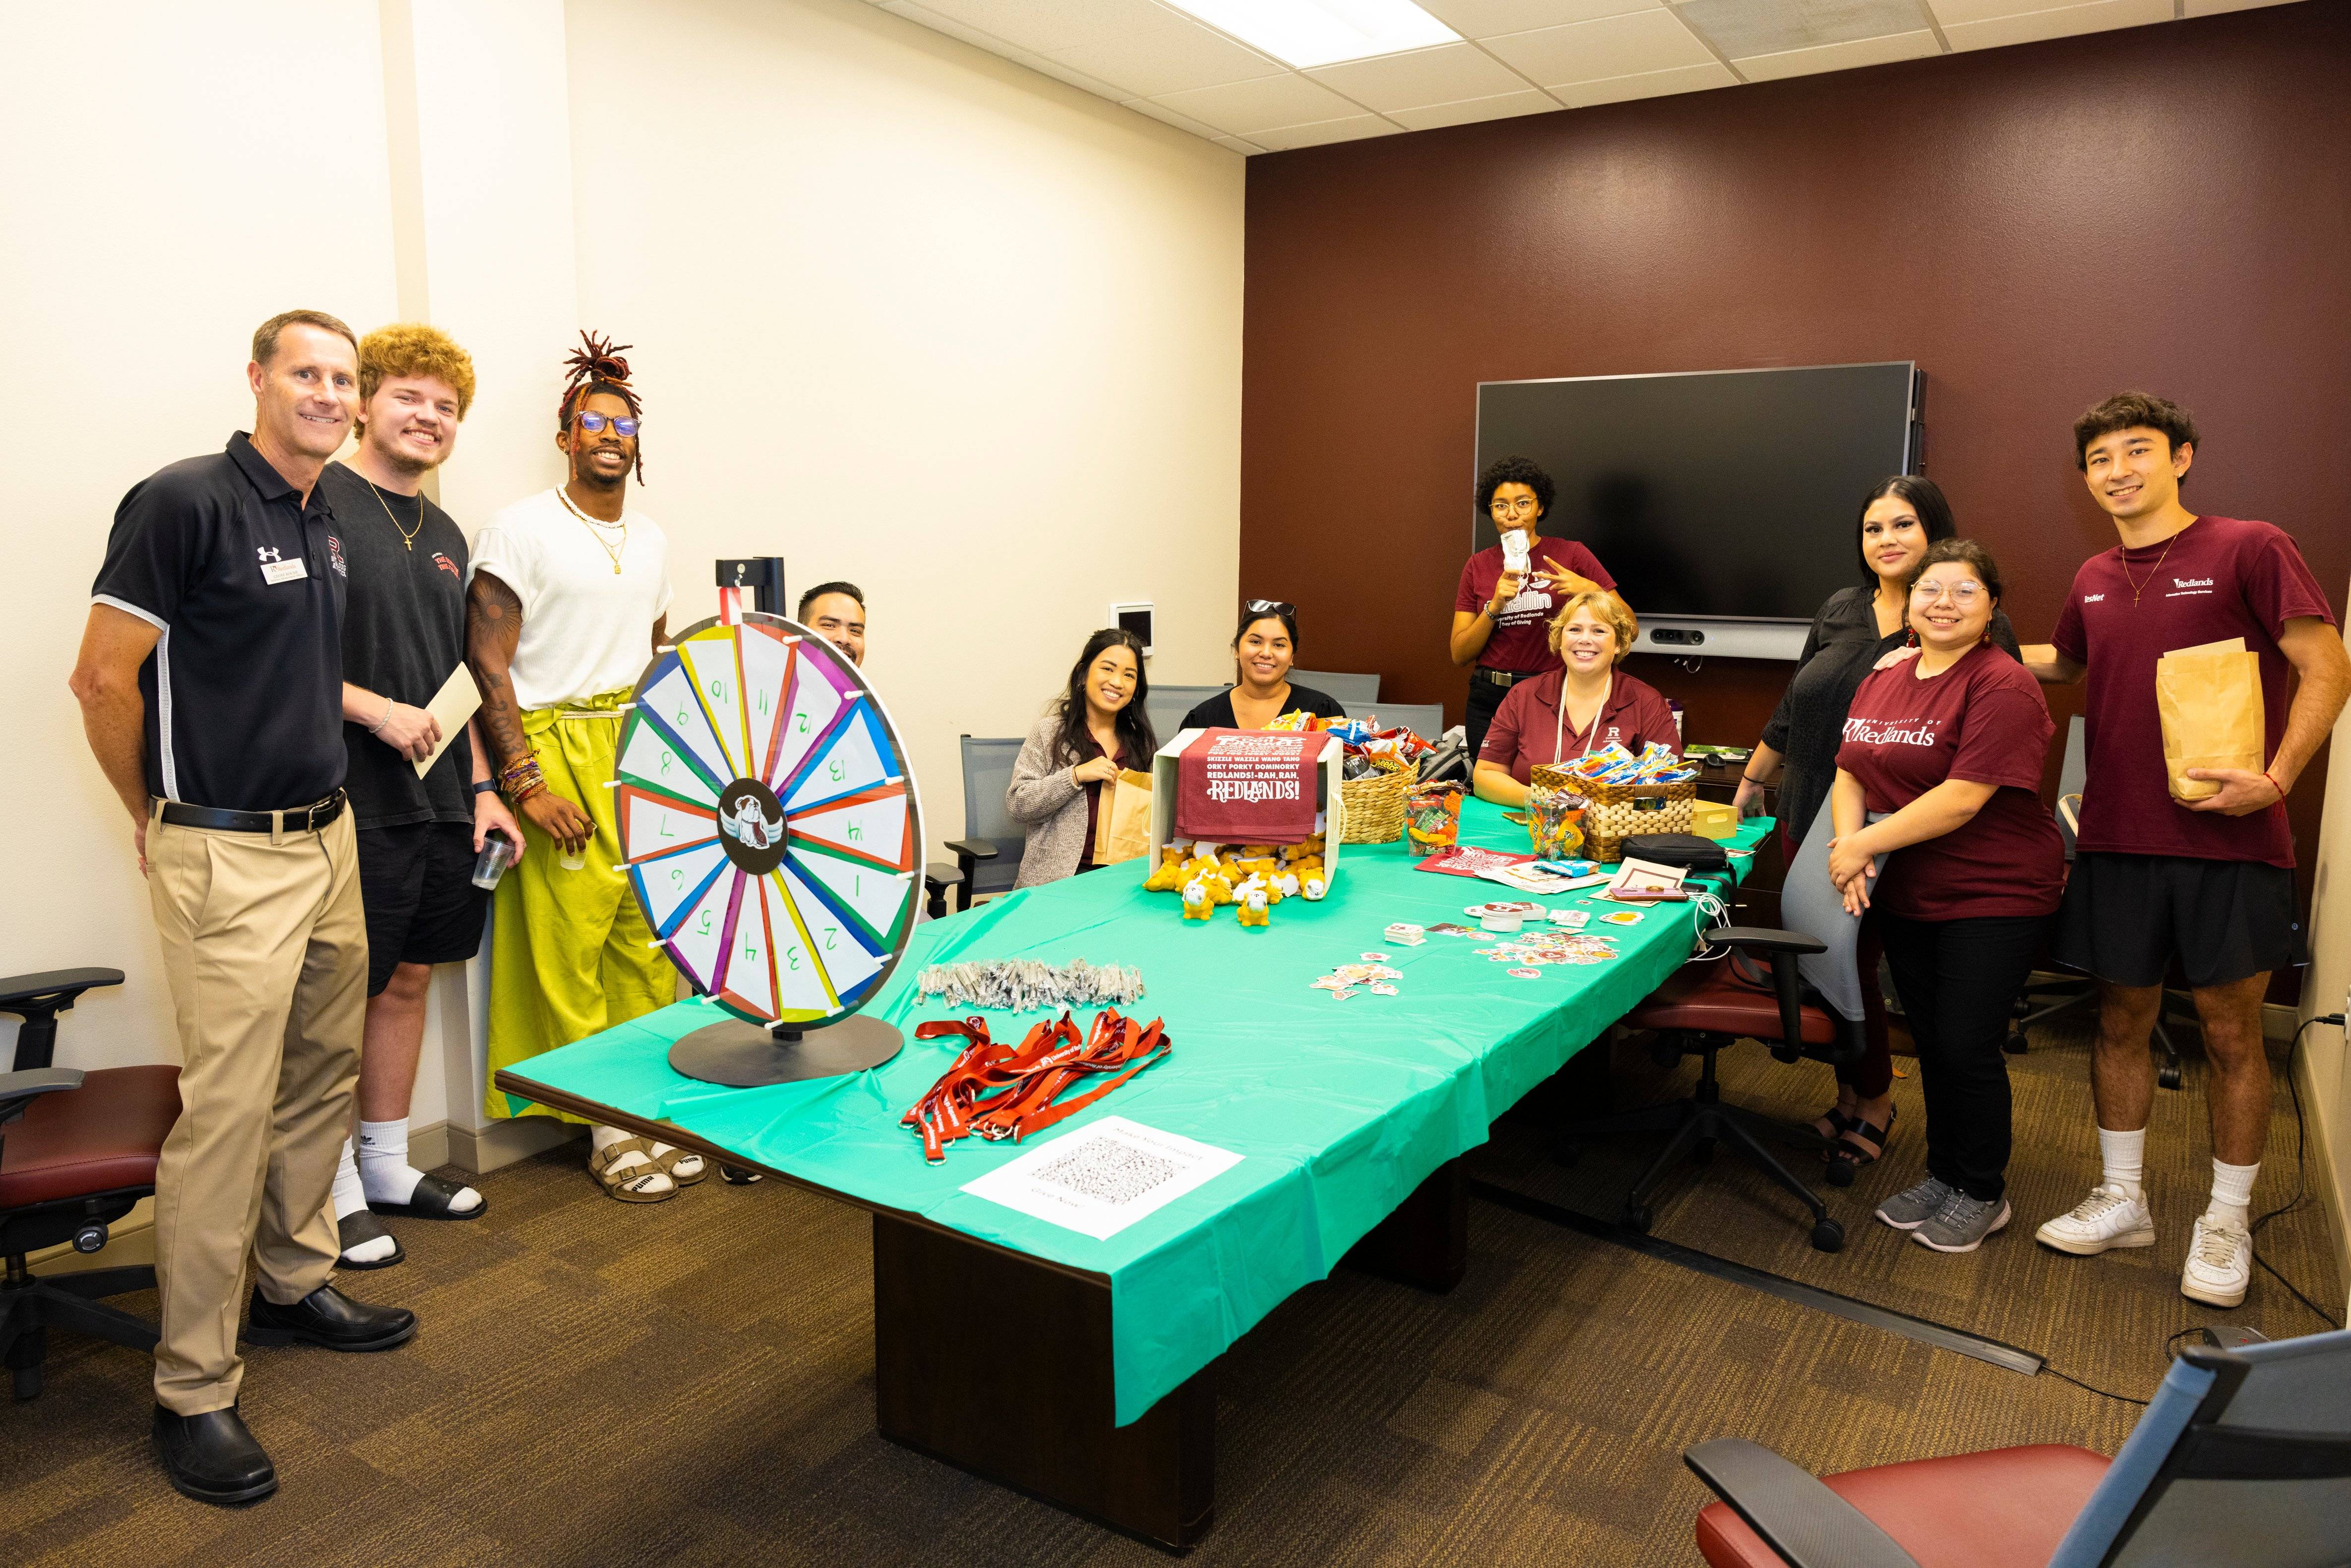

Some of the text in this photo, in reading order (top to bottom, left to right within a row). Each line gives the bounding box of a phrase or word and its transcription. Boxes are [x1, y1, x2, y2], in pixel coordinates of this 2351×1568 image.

[2177, 578, 2214, 588] Redlands
[1608, 727, 1620, 737] R
[1852, 726, 1935, 746] Redlands
[659, 751, 673, 777] 8
[1370, 758, 1401, 773] Cheetos
[1207, 780, 1300, 803] REDLANDS!
[696, 909, 712, 936] 5
[823, 927, 838, 951] 2
[1051, 1050, 1071, 1061] University
[1113, 1128, 1203, 1161] Make Your Impact
[632, 1175, 654, 1192] PUMA
[1031, 1188, 1055, 1198] Give
